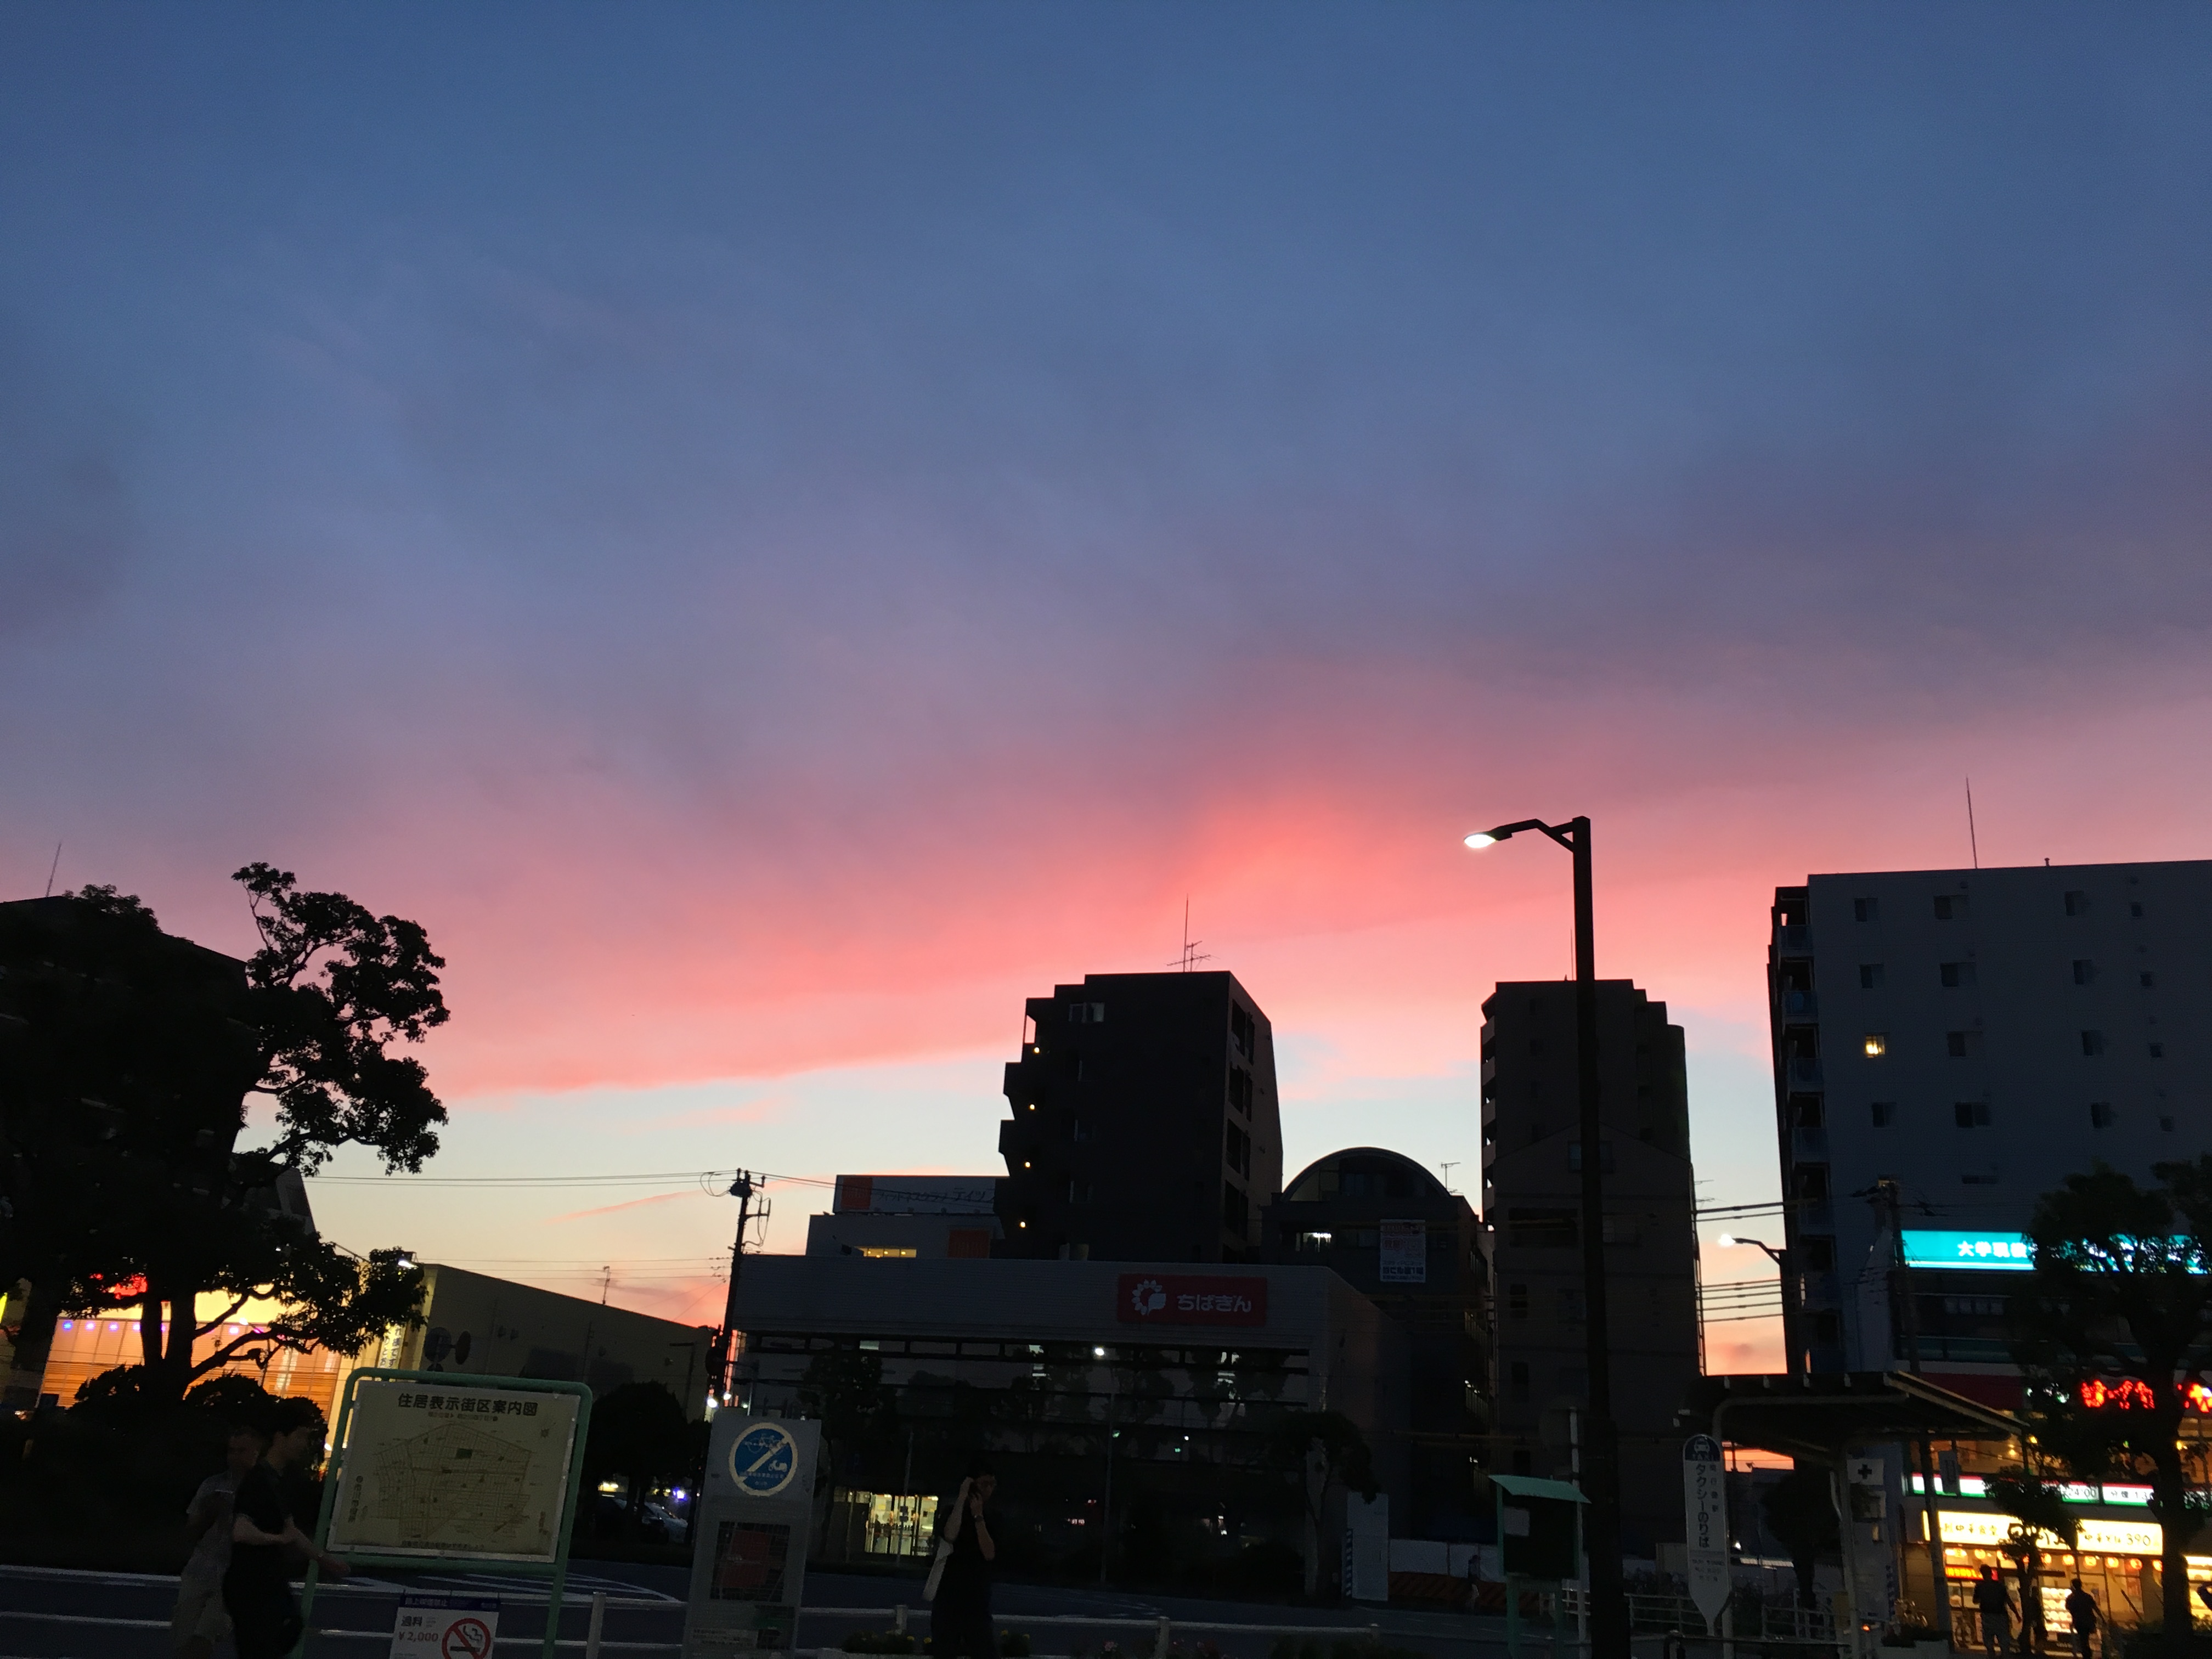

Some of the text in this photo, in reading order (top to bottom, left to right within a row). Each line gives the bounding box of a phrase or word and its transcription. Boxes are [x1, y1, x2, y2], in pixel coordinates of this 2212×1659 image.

[1177, 1294, 1251, 1313] ちばぎん
[398, 1393, 538, 1416] 住居表示街区案内図
